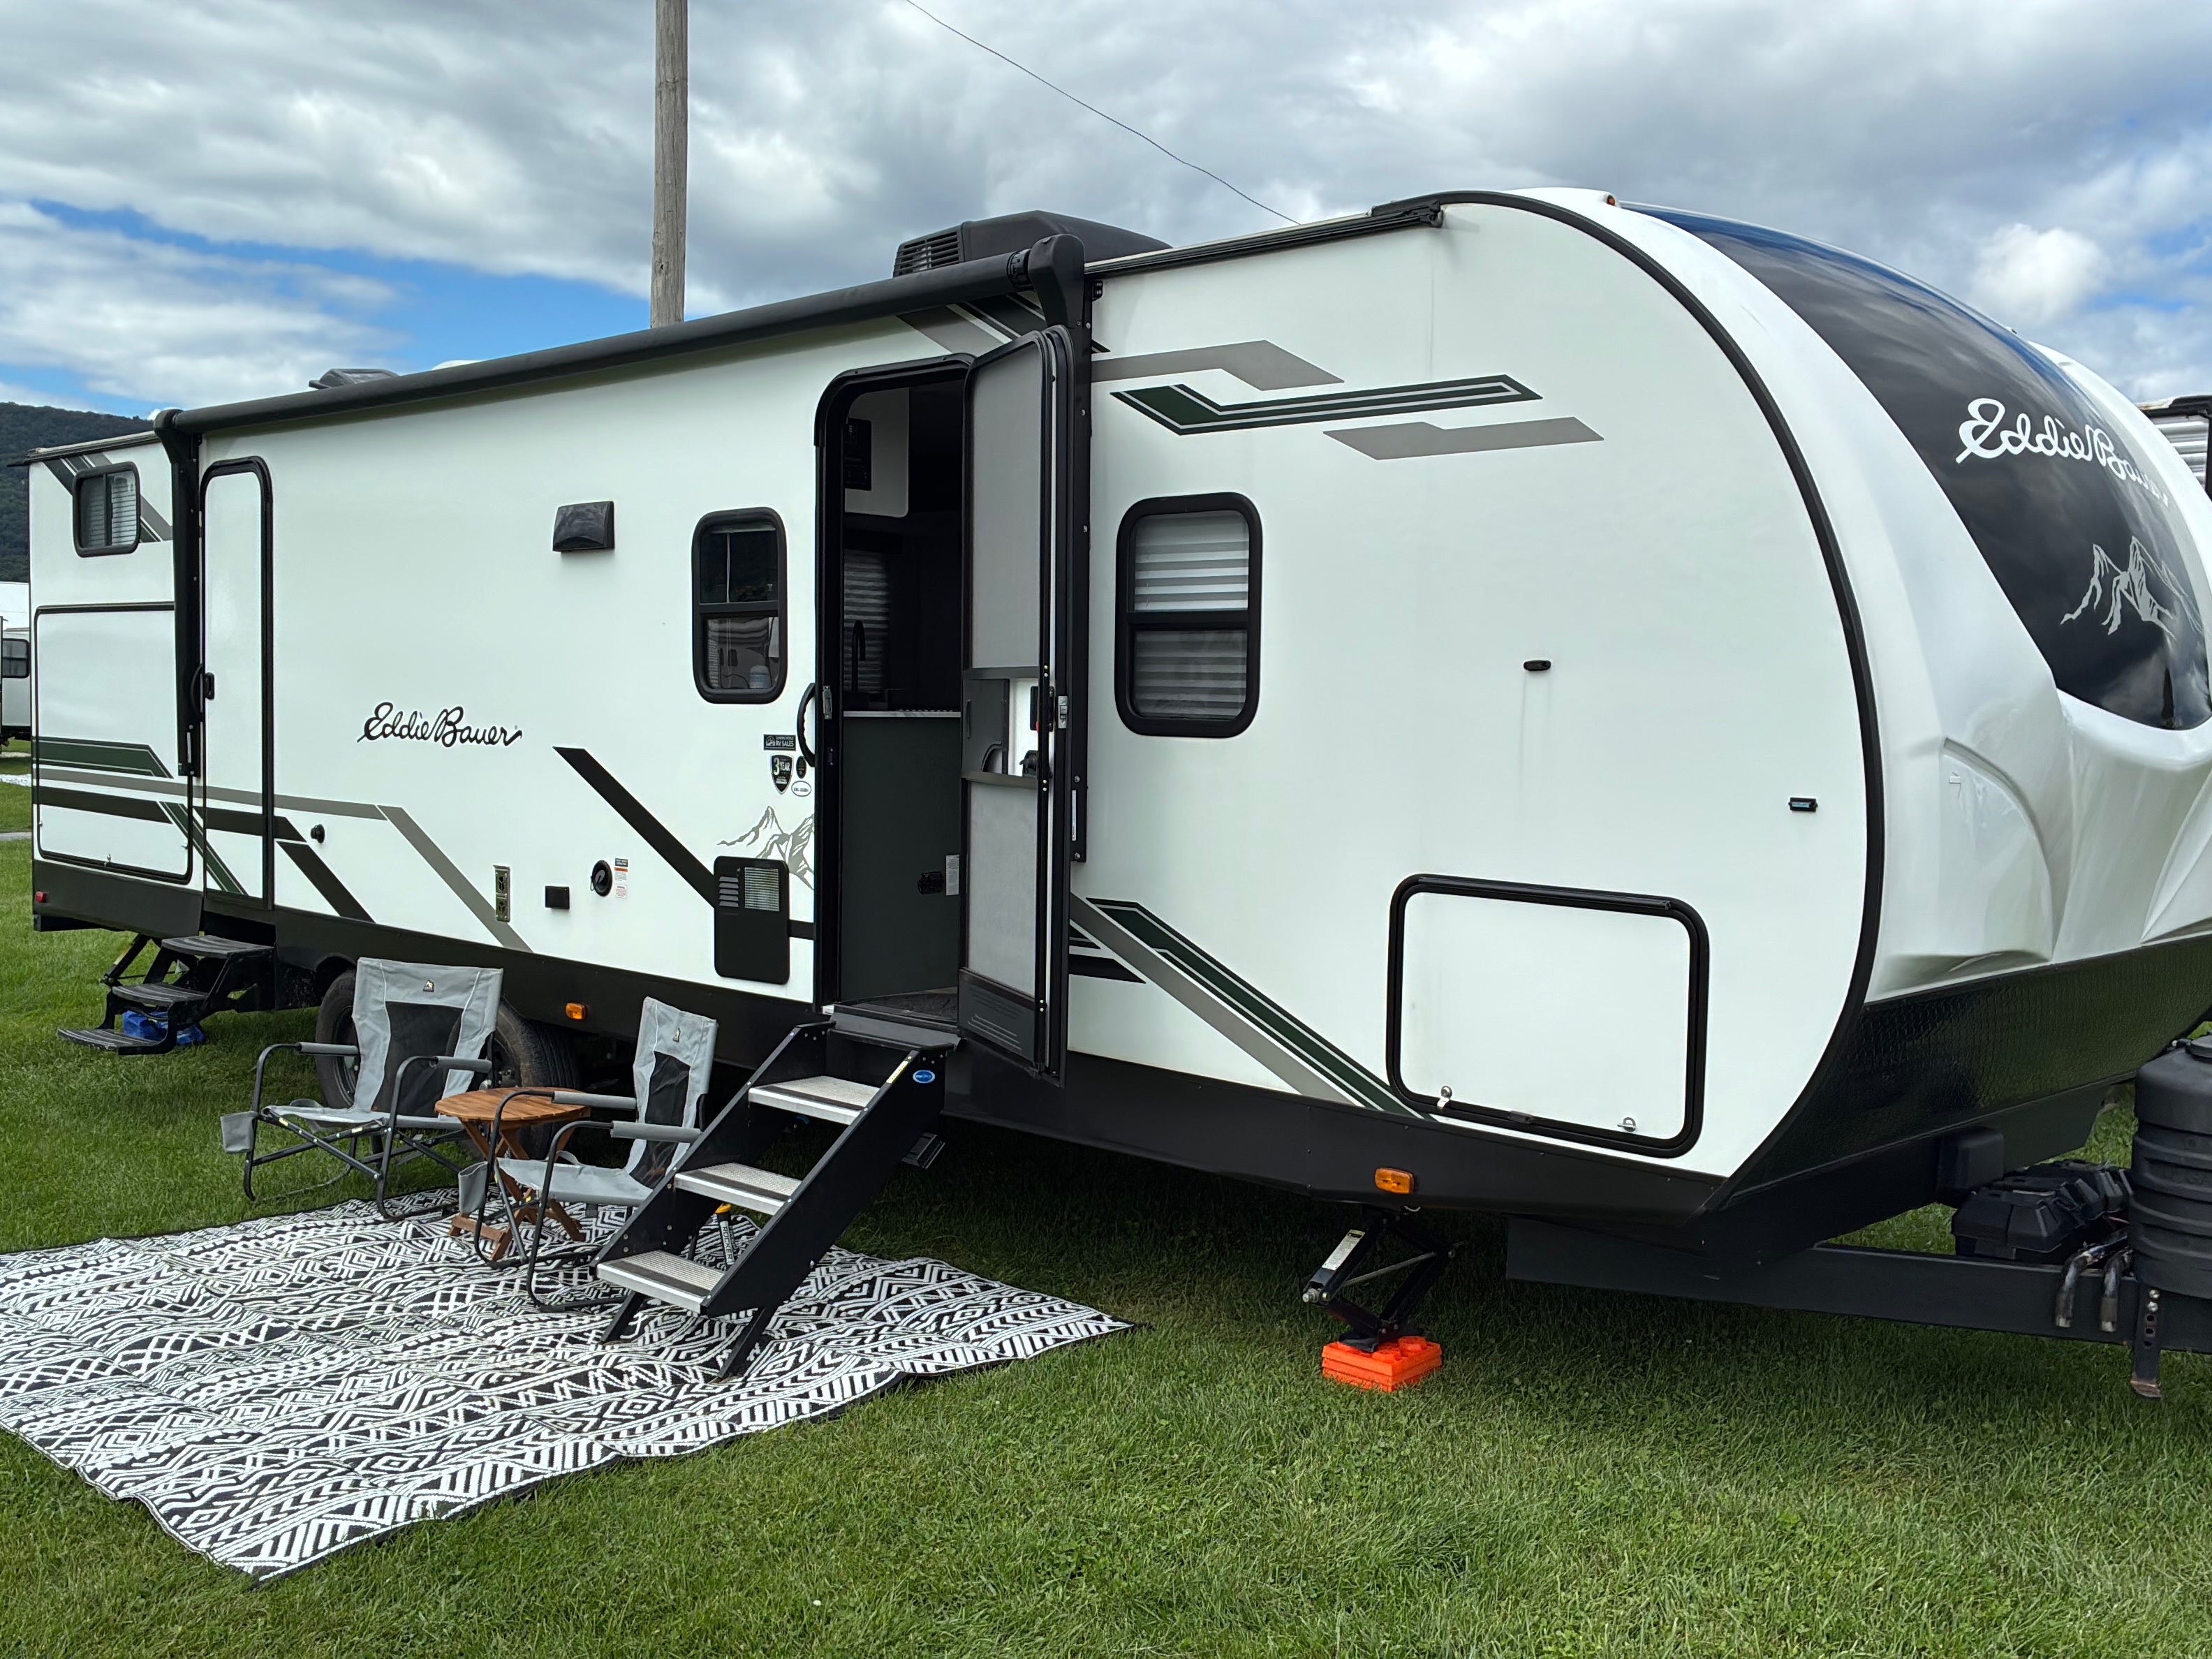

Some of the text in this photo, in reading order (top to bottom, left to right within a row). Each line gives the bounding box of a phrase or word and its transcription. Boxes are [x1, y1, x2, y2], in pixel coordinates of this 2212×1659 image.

[1956, 397, 2088, 464] Eddie
[357, 701, 523, 748] Eddie Bauer
[773, 757, 780, 776] 3
[779, 761, 790, 772] YEAR
[722, 1226, 733, 1260] ROCKER
